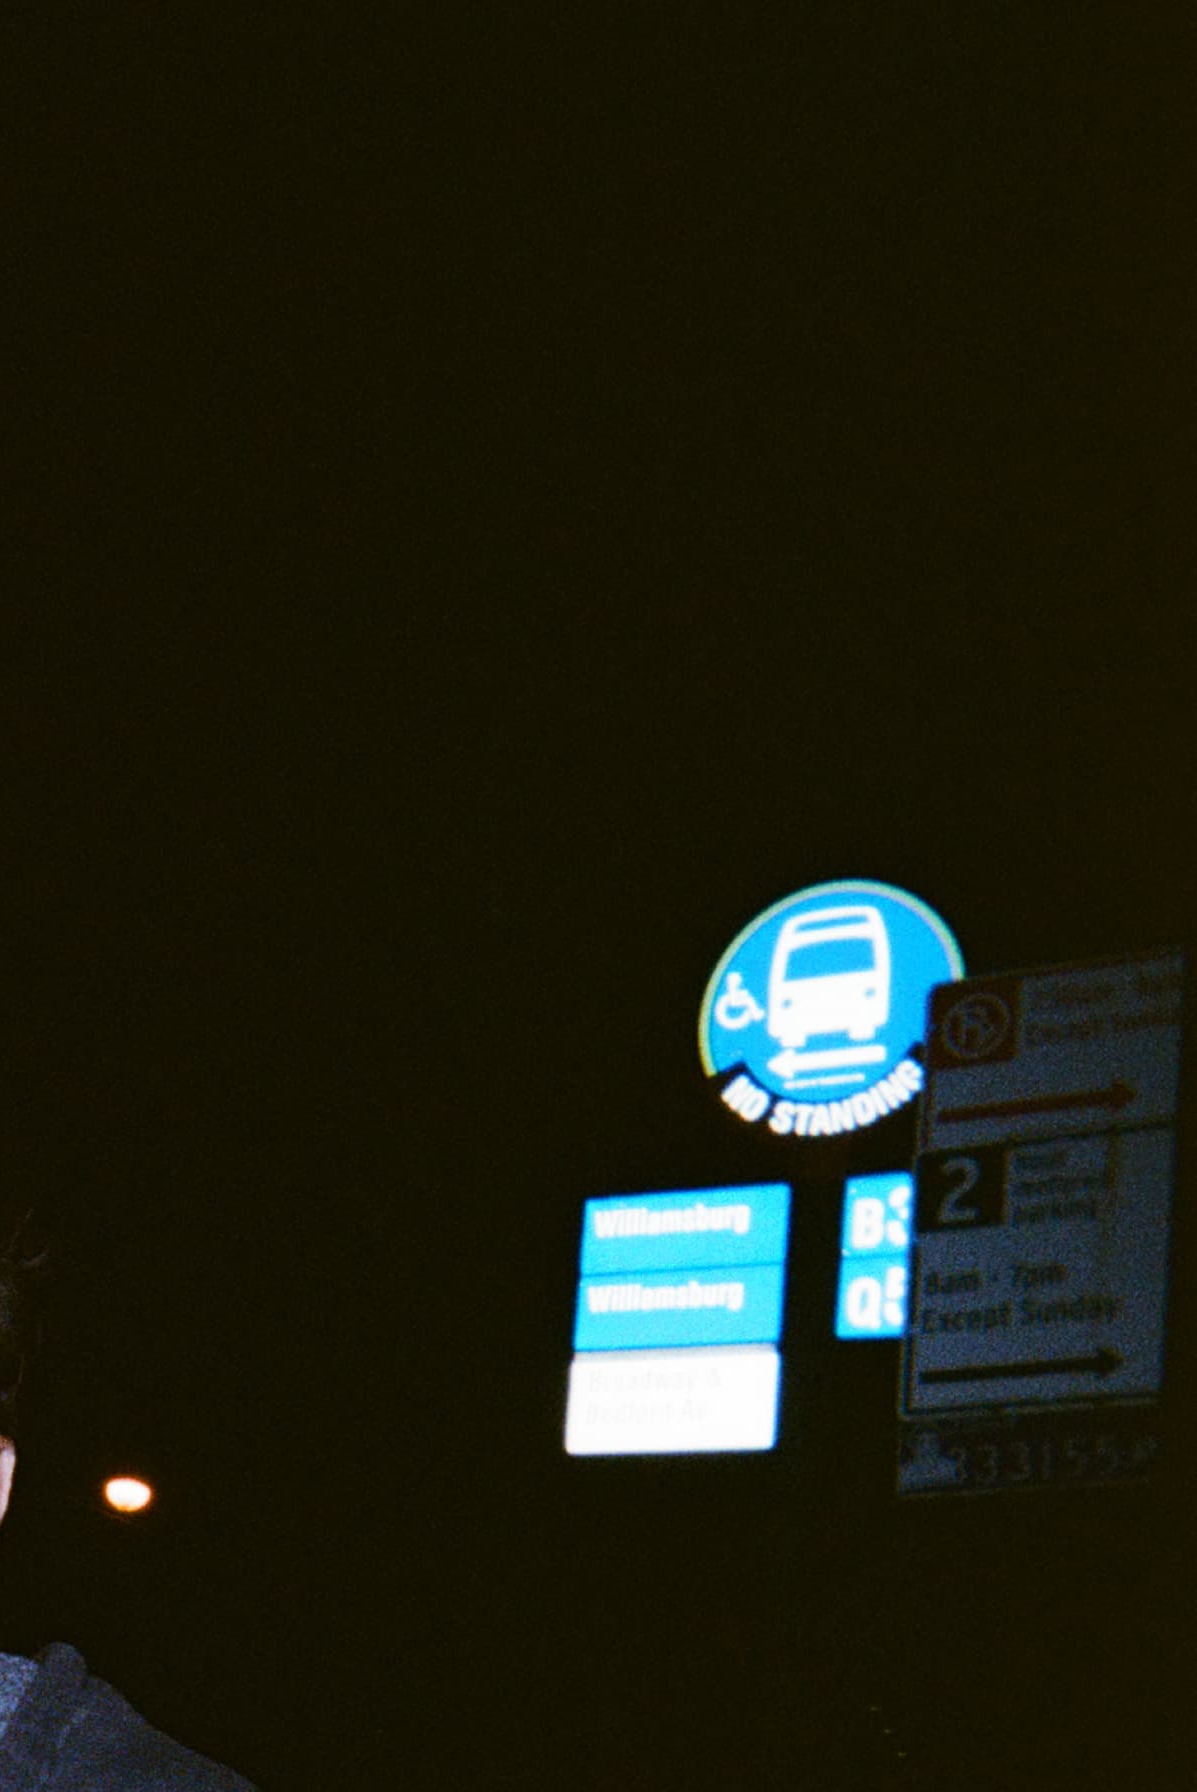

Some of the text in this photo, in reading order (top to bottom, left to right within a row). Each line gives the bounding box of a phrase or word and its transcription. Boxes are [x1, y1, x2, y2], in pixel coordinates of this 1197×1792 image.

[721, 1058, 925, 1136] NO STANDING
[938, 1157, 979, 1223] 2
[593, 1201, 752, 1240] Williamsburg
[587, 1279, 745, 1314] Williamsburg
